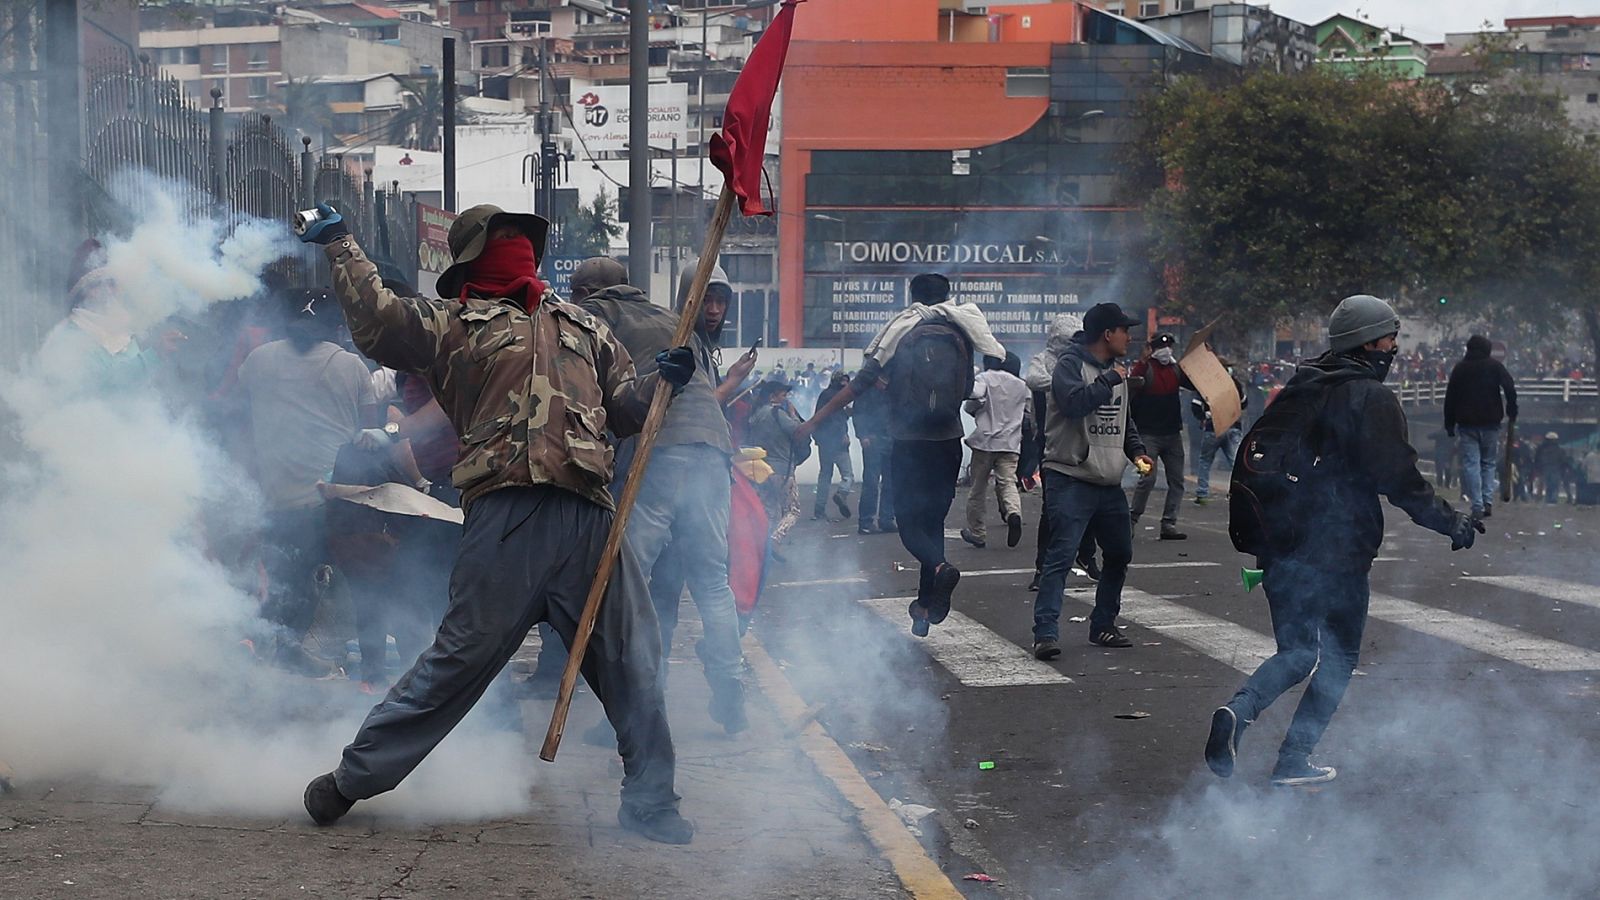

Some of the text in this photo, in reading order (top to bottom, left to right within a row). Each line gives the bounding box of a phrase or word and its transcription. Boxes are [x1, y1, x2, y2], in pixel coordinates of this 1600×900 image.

[616, 113, 681, 123] ECORIANO
[834, 241, 1033, 263] TOMOMEDICAL
[554, 259, 584, 271] COP
[556, 273, 573, 283] INT
[989, 323, 1031, 334] ONSULTAS
